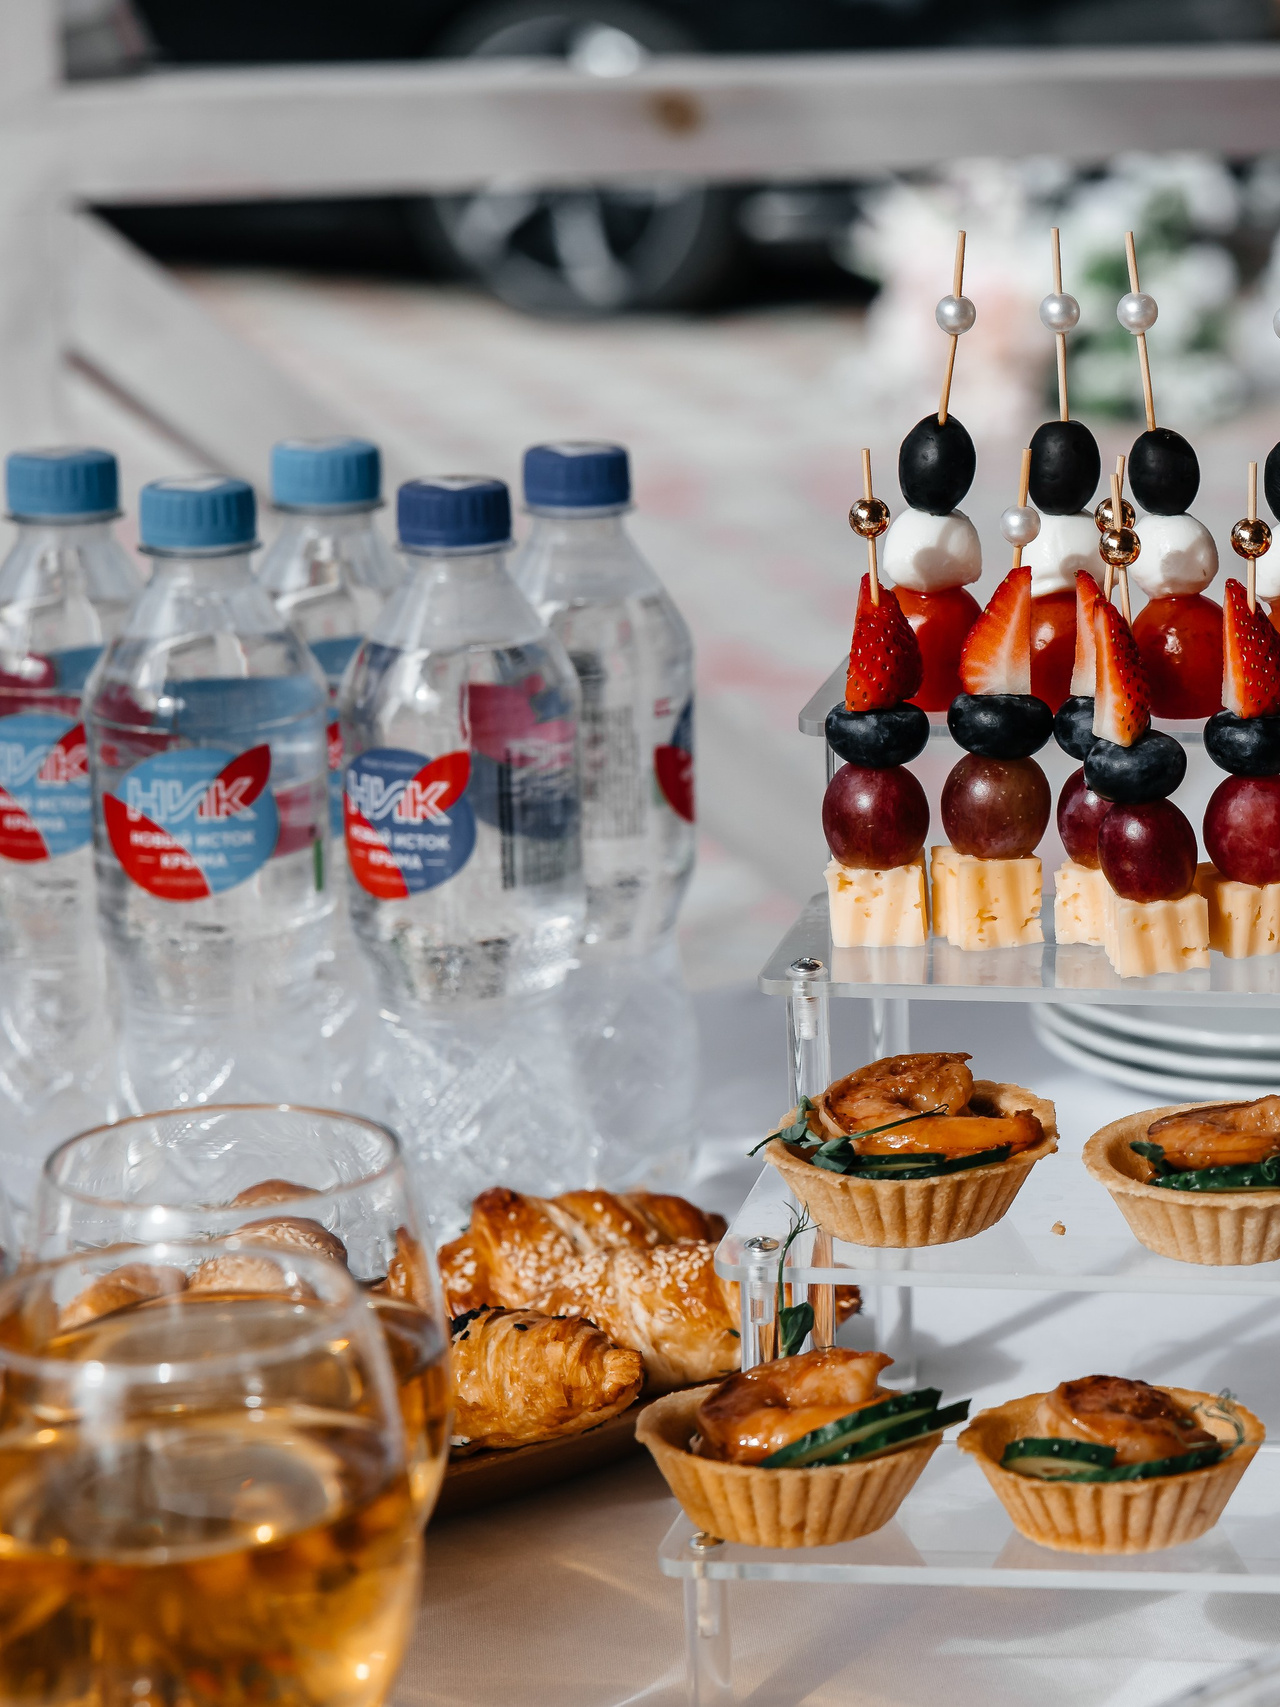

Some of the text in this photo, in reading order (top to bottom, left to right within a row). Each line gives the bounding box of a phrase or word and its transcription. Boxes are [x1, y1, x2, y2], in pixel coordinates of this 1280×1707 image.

[126, 776, 257, 824] НИК
[347, 769, 453, 826] НИК
[195, 829, 256, 849] ИСТОК
[393, 832, 451, 851] ИСТОК
[160, 852, 229, 870] КРЫМА
